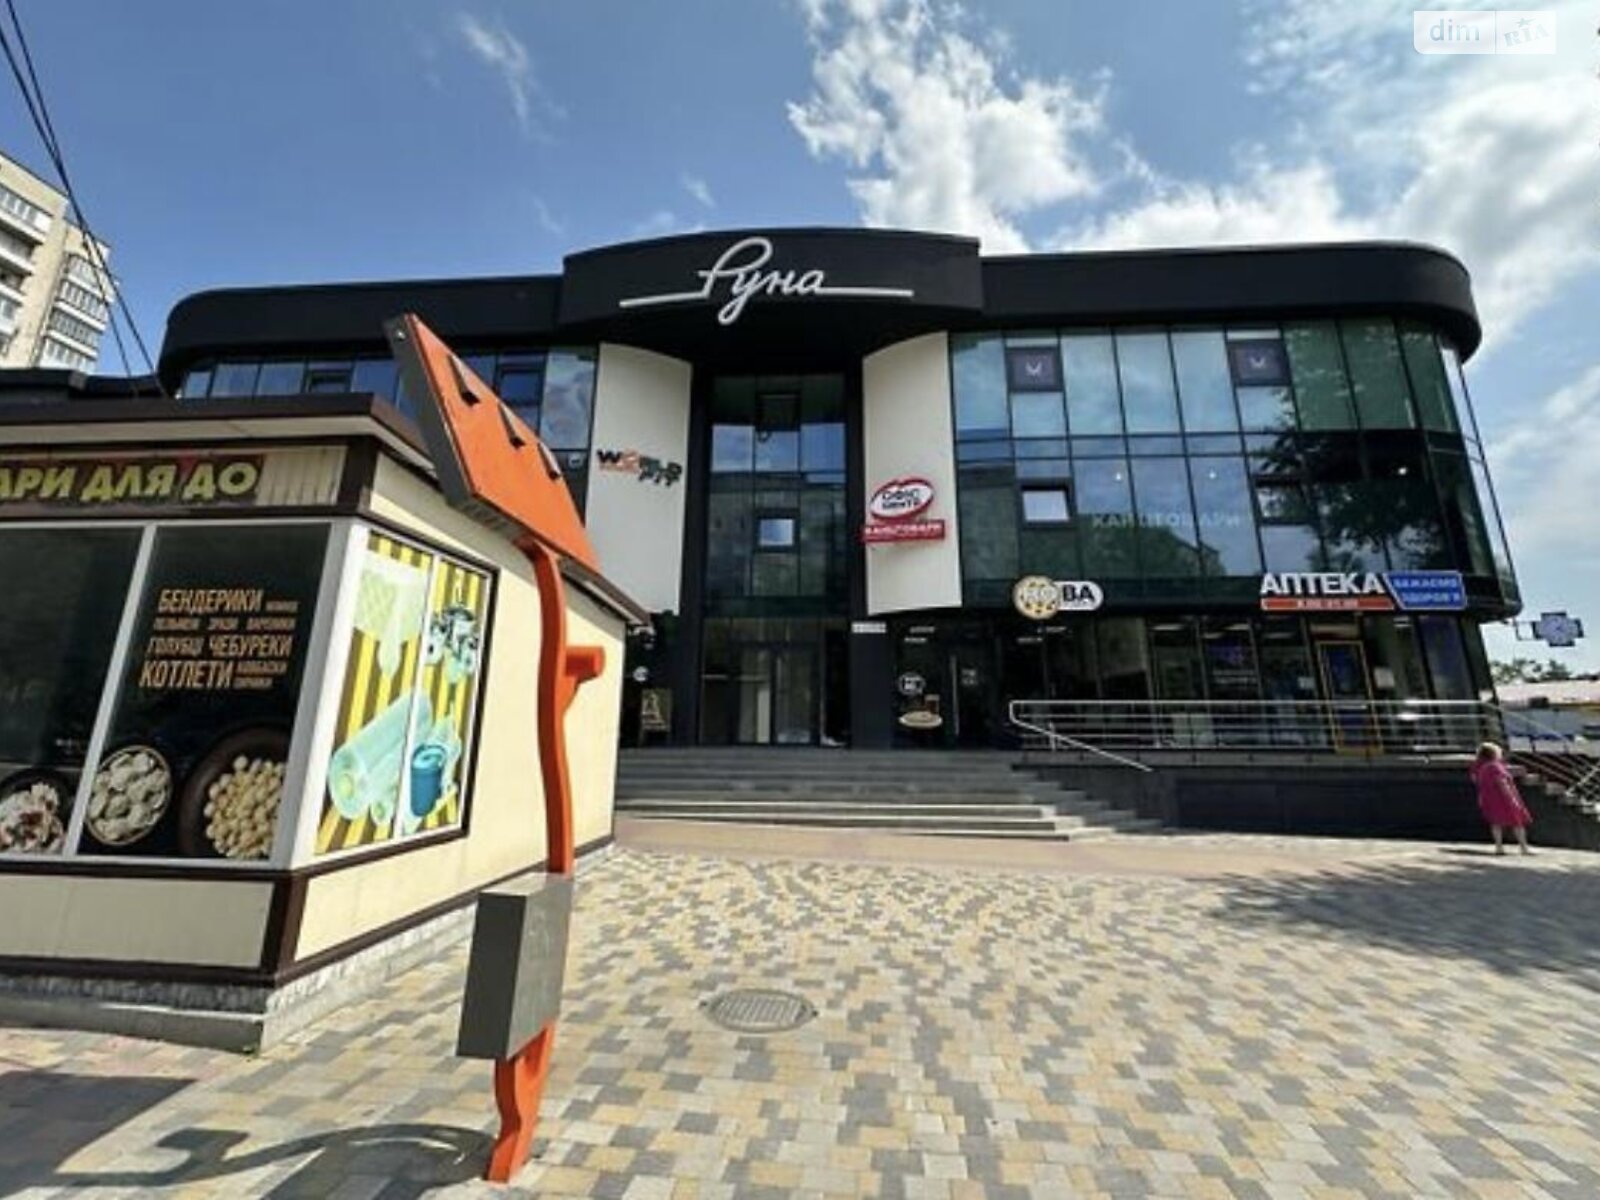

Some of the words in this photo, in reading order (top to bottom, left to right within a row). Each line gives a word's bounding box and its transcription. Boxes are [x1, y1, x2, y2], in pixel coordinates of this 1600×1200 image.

[80, 464, 177, 500] ДЛЯ
[182, 461, 257, 498] ДО
[1260, 572, 1385, 594] АПТЕКА
[158, 589, 264, 614] БЕНДЕРИКИ
[208, 634, 294, 657] ЧЕБУРЕКИ
[138, 659, 235, 689] КОТЛЕТИ
